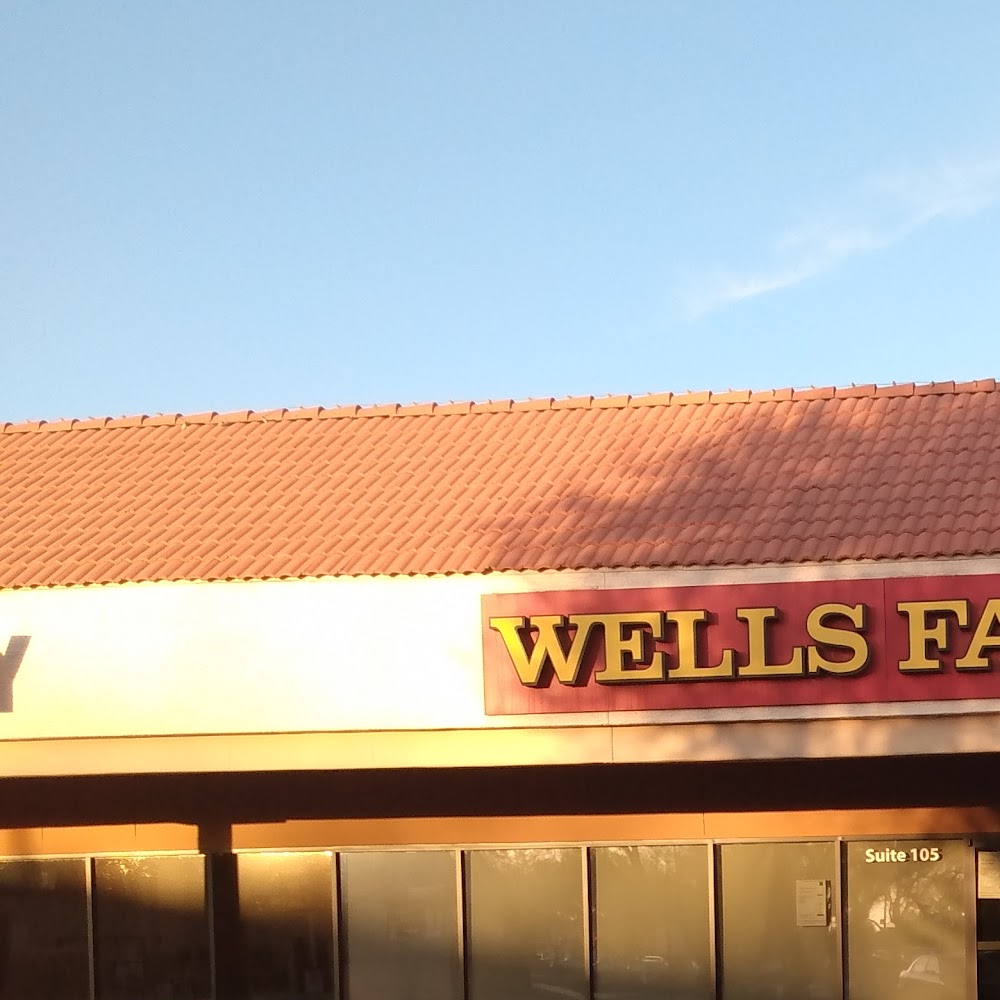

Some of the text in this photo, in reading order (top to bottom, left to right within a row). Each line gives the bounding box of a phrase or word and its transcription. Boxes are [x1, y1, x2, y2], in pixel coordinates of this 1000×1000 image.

[489, 601, 870, 687] WELLS
[865, 847, 941, 863] Suite 105
